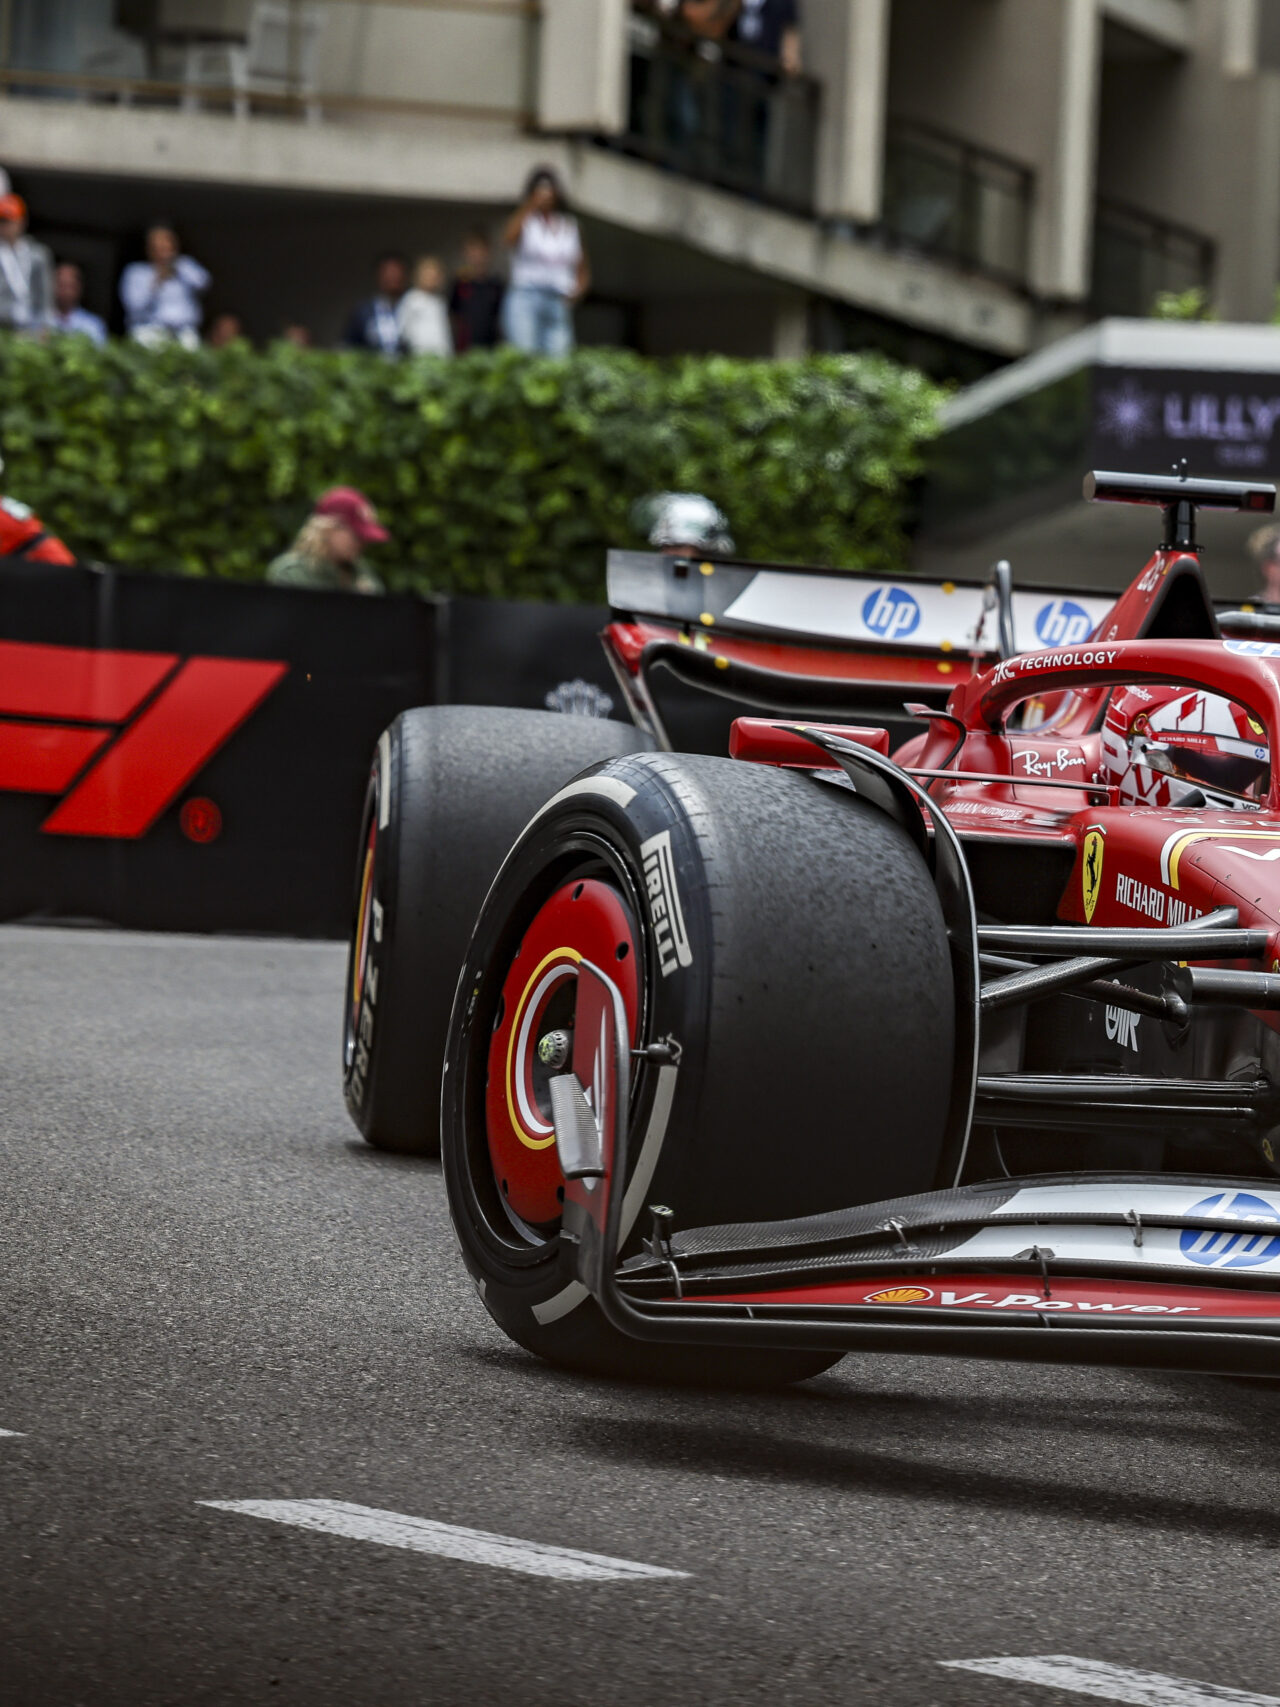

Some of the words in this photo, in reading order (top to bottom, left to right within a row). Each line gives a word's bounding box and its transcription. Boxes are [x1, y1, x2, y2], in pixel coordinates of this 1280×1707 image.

[864, 586, 919, 640] hp
[1037, 601, 1092, 647] hp
[1020, 651, 1117, 671] TECHNOLOGY
[1013, 748, 1086, 777] Ray-Ban
[372, 897, 384, 943] P
[640, 830, 693, 979] PIRELLI
[1116, 872, 1165, 922] RICHARD
[1183, 1192, 1280, 1267] hp
[940, 1291, 1201, 1314] V-Power
